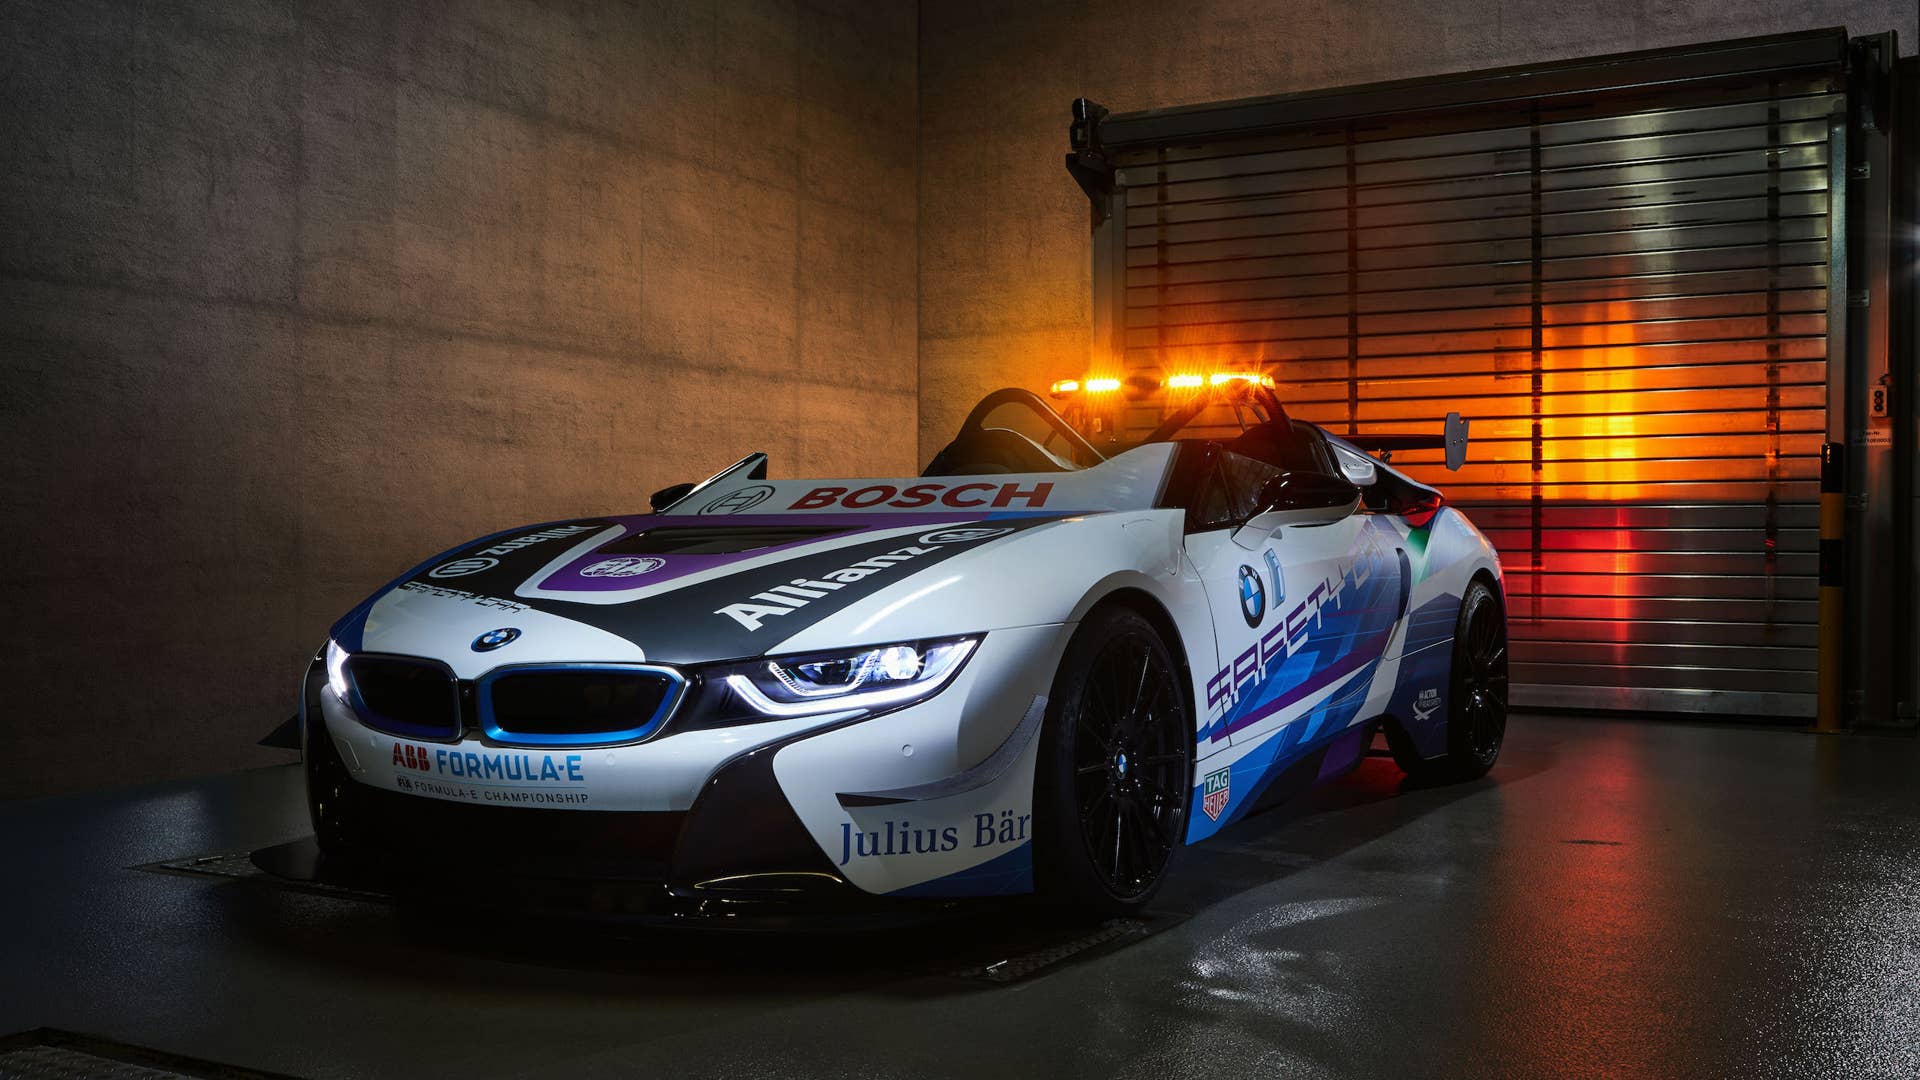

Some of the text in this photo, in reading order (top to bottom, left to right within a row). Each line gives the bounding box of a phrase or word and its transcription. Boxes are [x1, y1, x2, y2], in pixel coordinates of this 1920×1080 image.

[787, 482, 1055, 510] BOSCH
[713, 543, 943, 632] Allianz
[393, 742, 430, 771] ABB
[415, 782, 478, 800] FORMULA-E
[485, 791, 589, 804] CHAMPIONSHIP
[1206, 771, 1229, 793] TAG
[1204, 790, 1229, 817] HEUER
[840, 809, 1031, 866] Julius Bär
